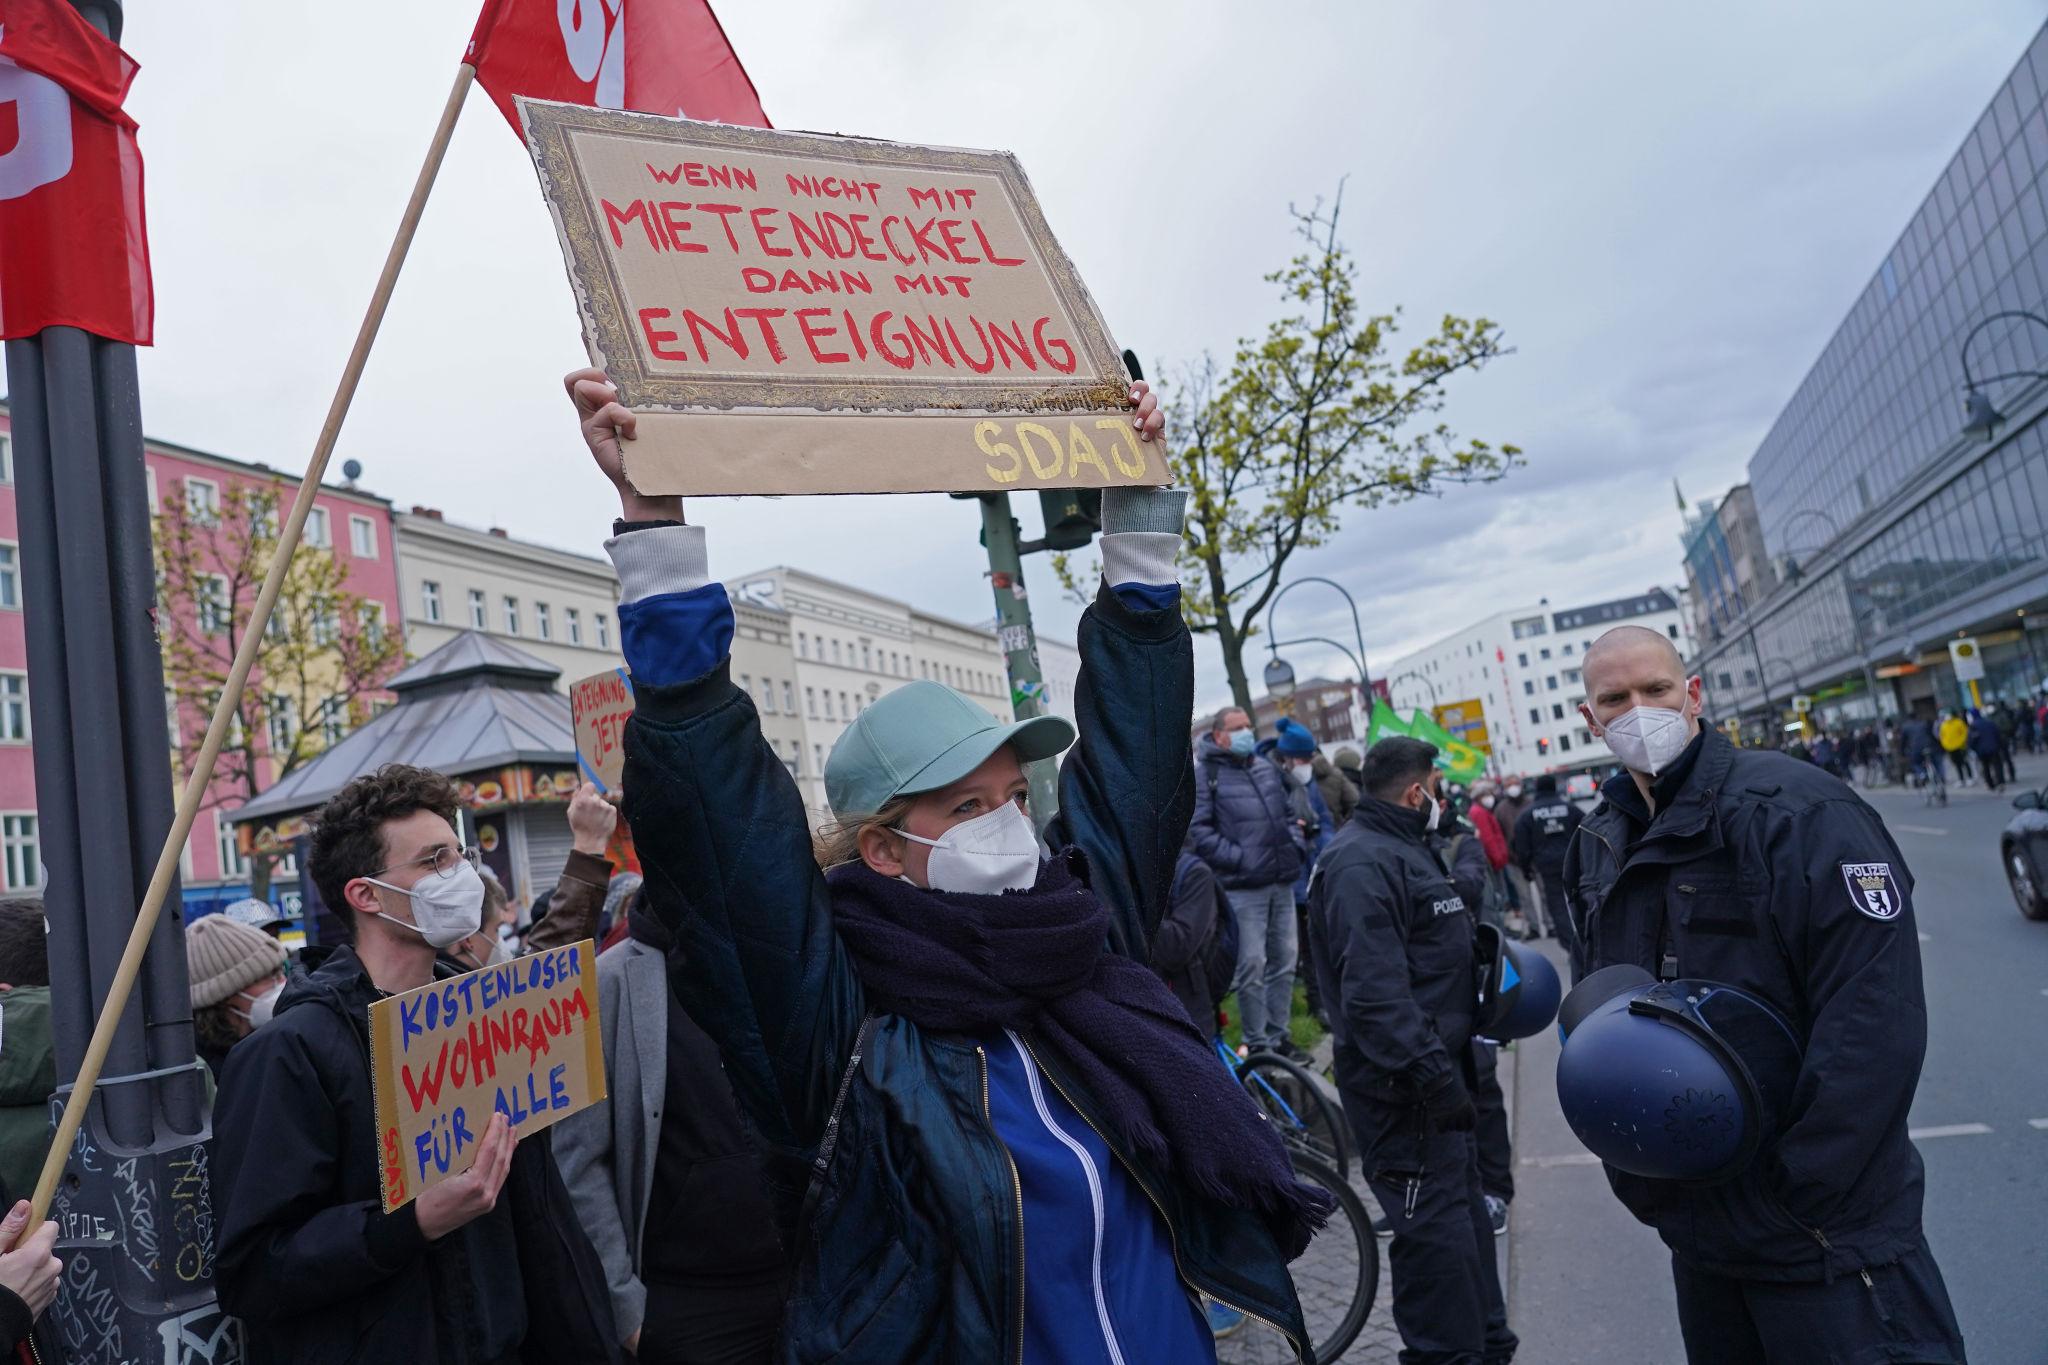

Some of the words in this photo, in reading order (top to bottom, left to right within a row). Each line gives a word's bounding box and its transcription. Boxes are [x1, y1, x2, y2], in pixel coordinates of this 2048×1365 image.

[647, 162, 757, 190] WENN
[785, 174, 881, 205] NICHT
[907, 187, 977, 212] MIT
[601, 199, 1026, 267] MIETENDECKEL
[741, 267, 873, 295] DANN
[894, 273, 971, 298] MIT
[638, 307, 1076, 374] ENTEIGNUNG
[974, 417, 1146, 483] SDAJ
[1845, 866, 1888, 877] POLIZEI
[400, 947, 581, 1053] KOSTENLOSER
[402, 987, 590, 1113] WOHNRAUM
[414, 1107, 474, 1183] FÜR
[494, 1063, 570, 1127] ALLE
[383, 1127, 406, 1206] SDAJ
